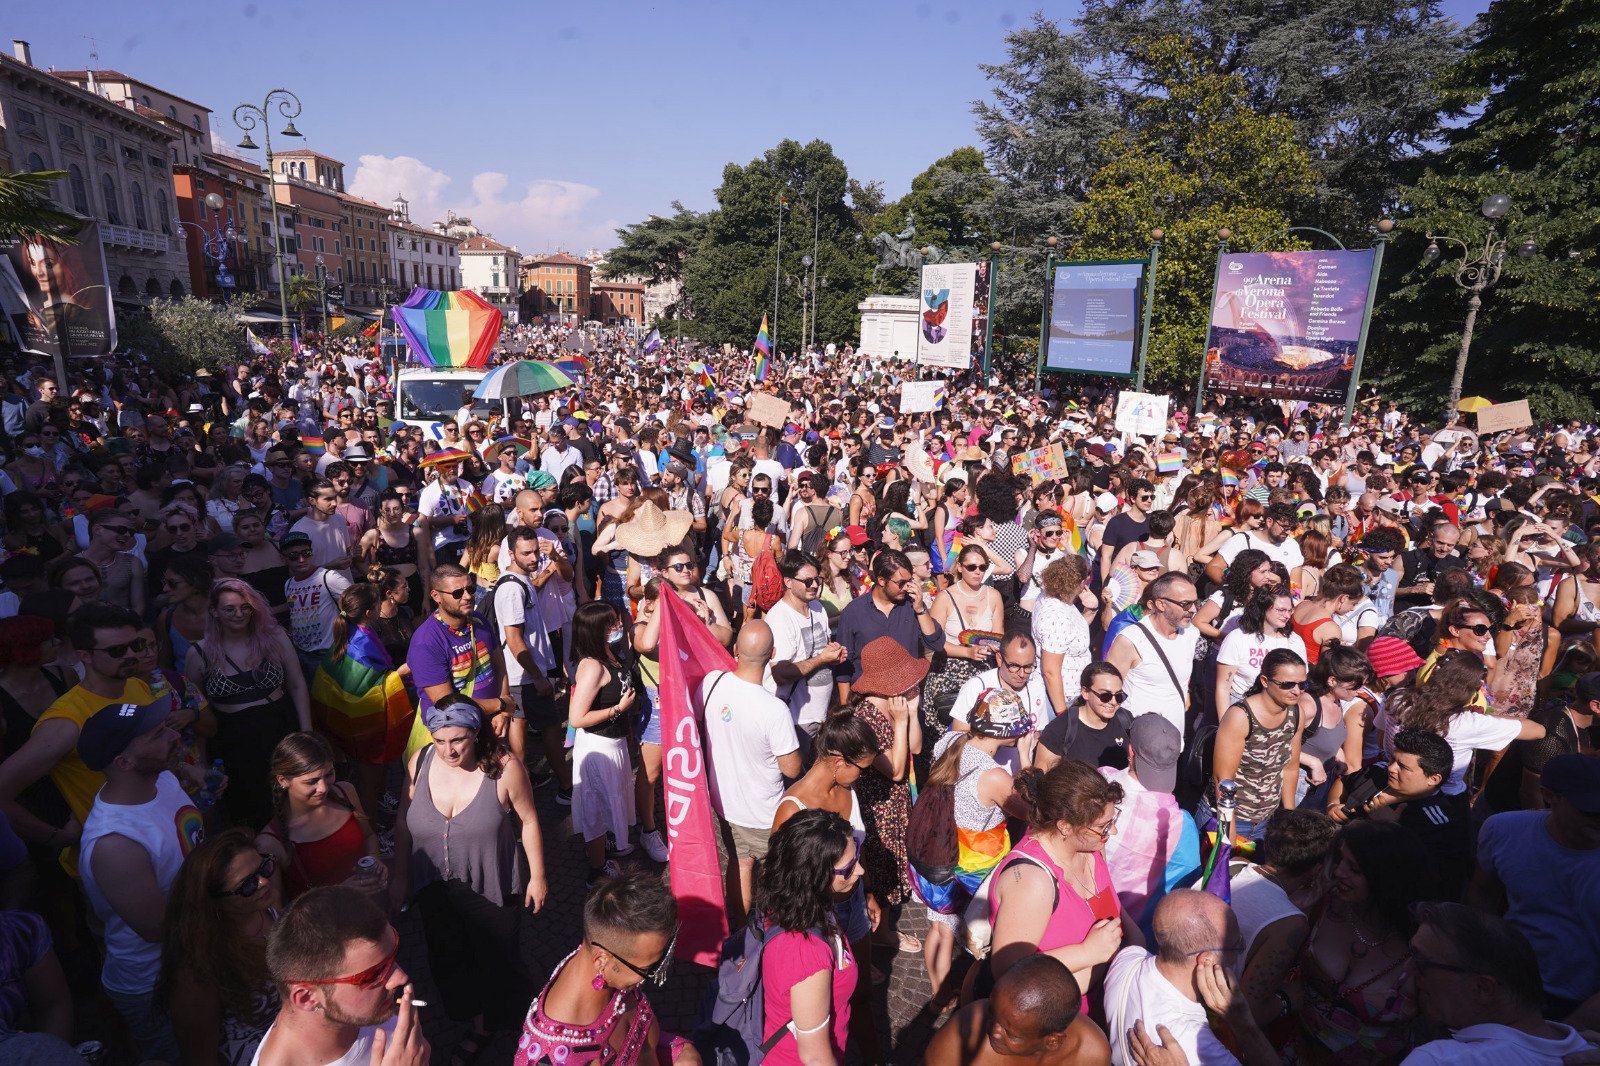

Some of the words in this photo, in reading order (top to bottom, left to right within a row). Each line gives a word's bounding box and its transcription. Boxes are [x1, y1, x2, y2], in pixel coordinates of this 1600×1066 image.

[1258, 274, 1292, 285] Arena
[1244, 285, 1285, 296] Verona
[1244, 294, 1284, 311] Opera
[1240, 307, 1286, 320] Festival
[1013, 454, 1021, 463] AS
